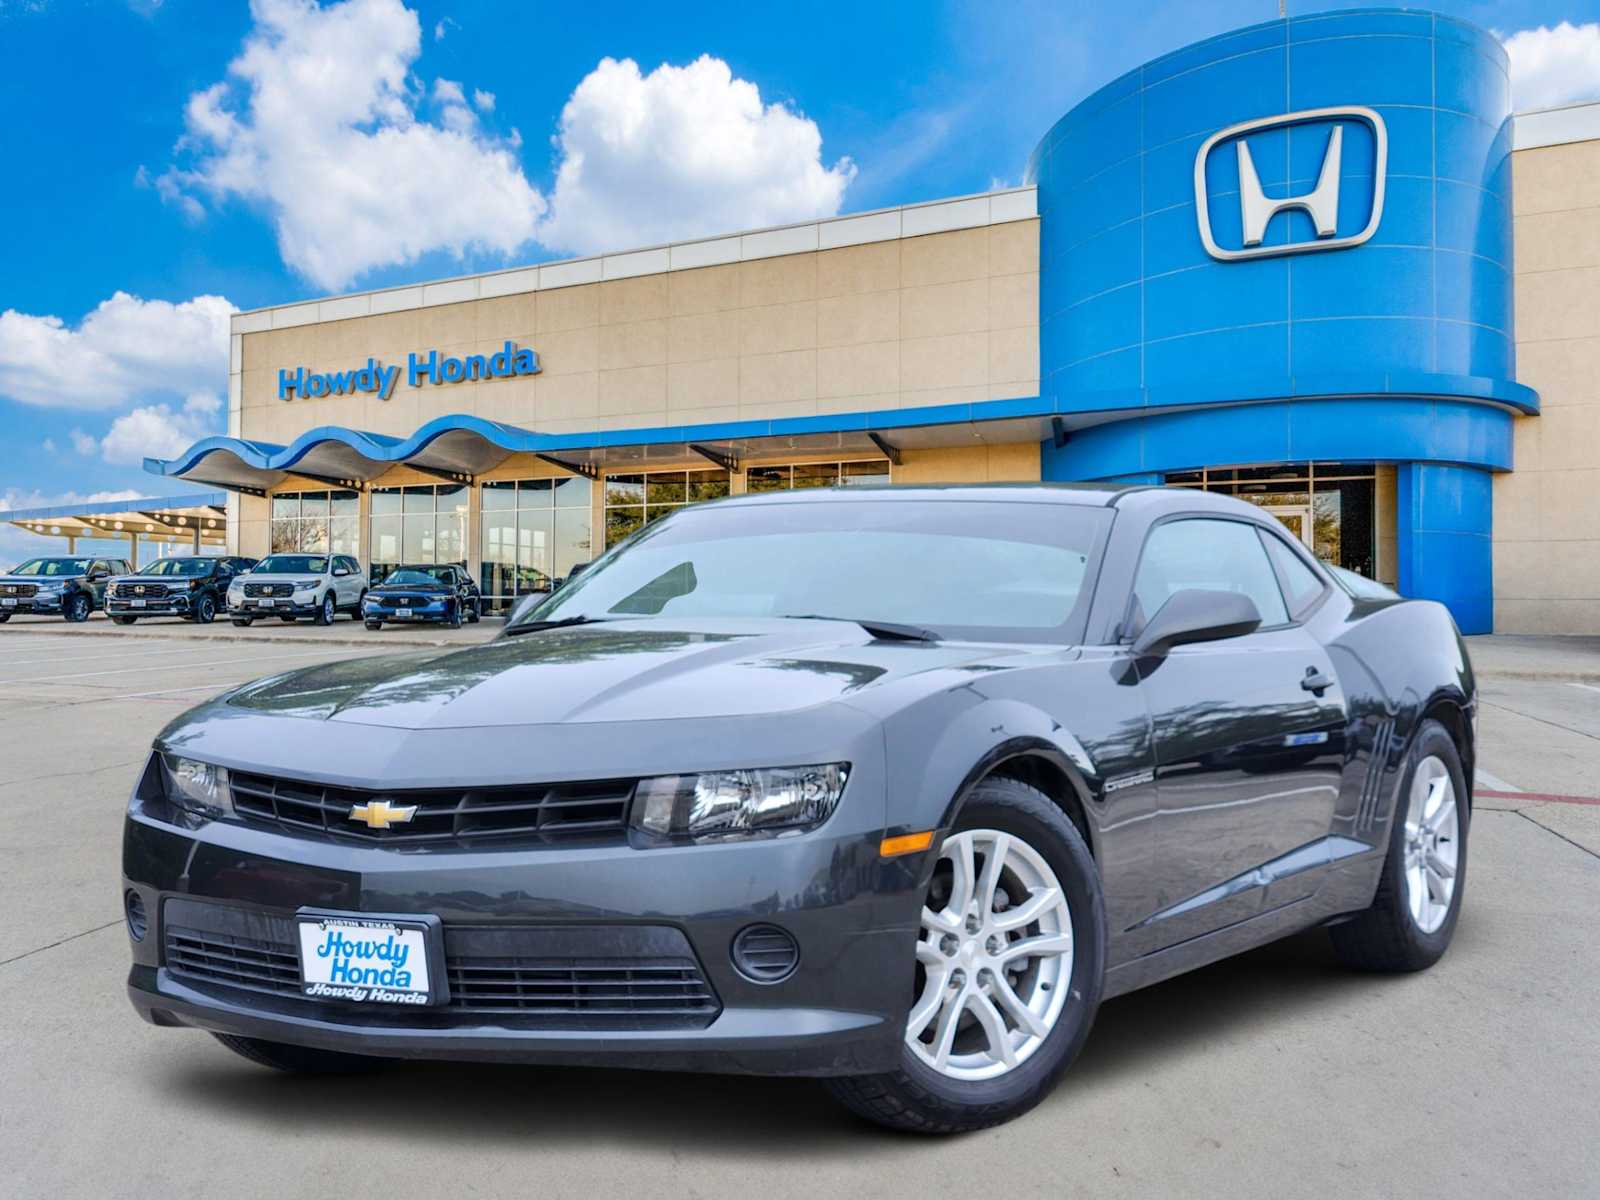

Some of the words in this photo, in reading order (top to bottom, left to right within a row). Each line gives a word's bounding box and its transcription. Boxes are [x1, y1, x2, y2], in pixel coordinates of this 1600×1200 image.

[278, 358, 401, 401] Howdy
[408, 341, 542, 388] Honda
[323, 919, 359, 928] AUSTIN
[361, 922, 395, 930] TEXAS
[317, 931, 409, 968] Howdy
[330, 957, 412, 988] Honda
[306, 983, 368, 1002] Howdy
[369, 988, 428, 1004] Honda
